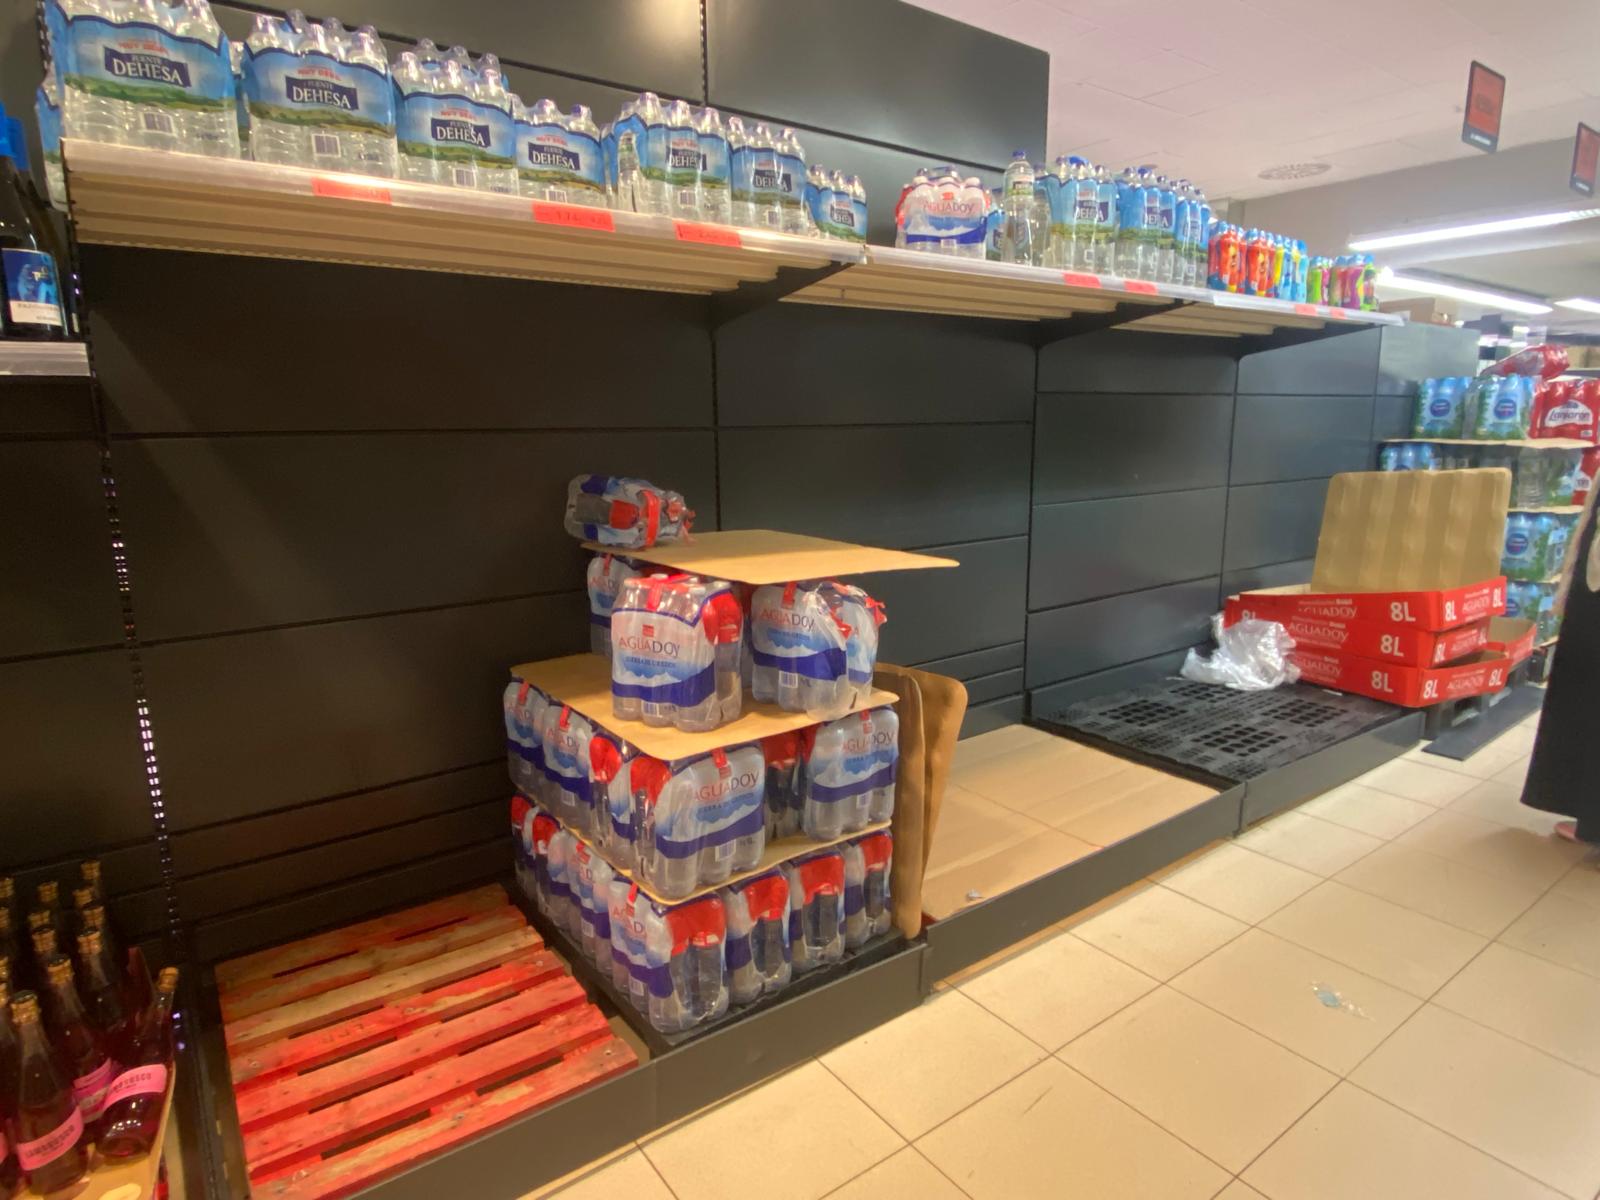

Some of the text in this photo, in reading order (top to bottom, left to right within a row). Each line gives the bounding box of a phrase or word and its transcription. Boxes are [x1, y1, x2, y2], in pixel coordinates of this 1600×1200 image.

[113, 58, 184, 86] DEHESA
[292, 86, 351, 109] DEHESA
[436, 126, 485, 147] DEHESA
[532, 150, 576, 170] DEHESA
[1493, 587, 1503, 608] 8L
[761, 608, 815, 632] AGUADOY
[1391, 602, 1416, 622] 8L
[1445, 600, 1457, 622] 8L
[1288, 622, 1349, 643] AGUADOY
[618, 636, 680, 659] AGUADOY
[1381, 635, 1404, 657] 8L
[1372, 670, 1394, 692] 8L
[1424, 680, 1438, 698] 8L
[1489, 668, 1503, 686] 8L
[696, 771, 760, 801] AGUADOY
